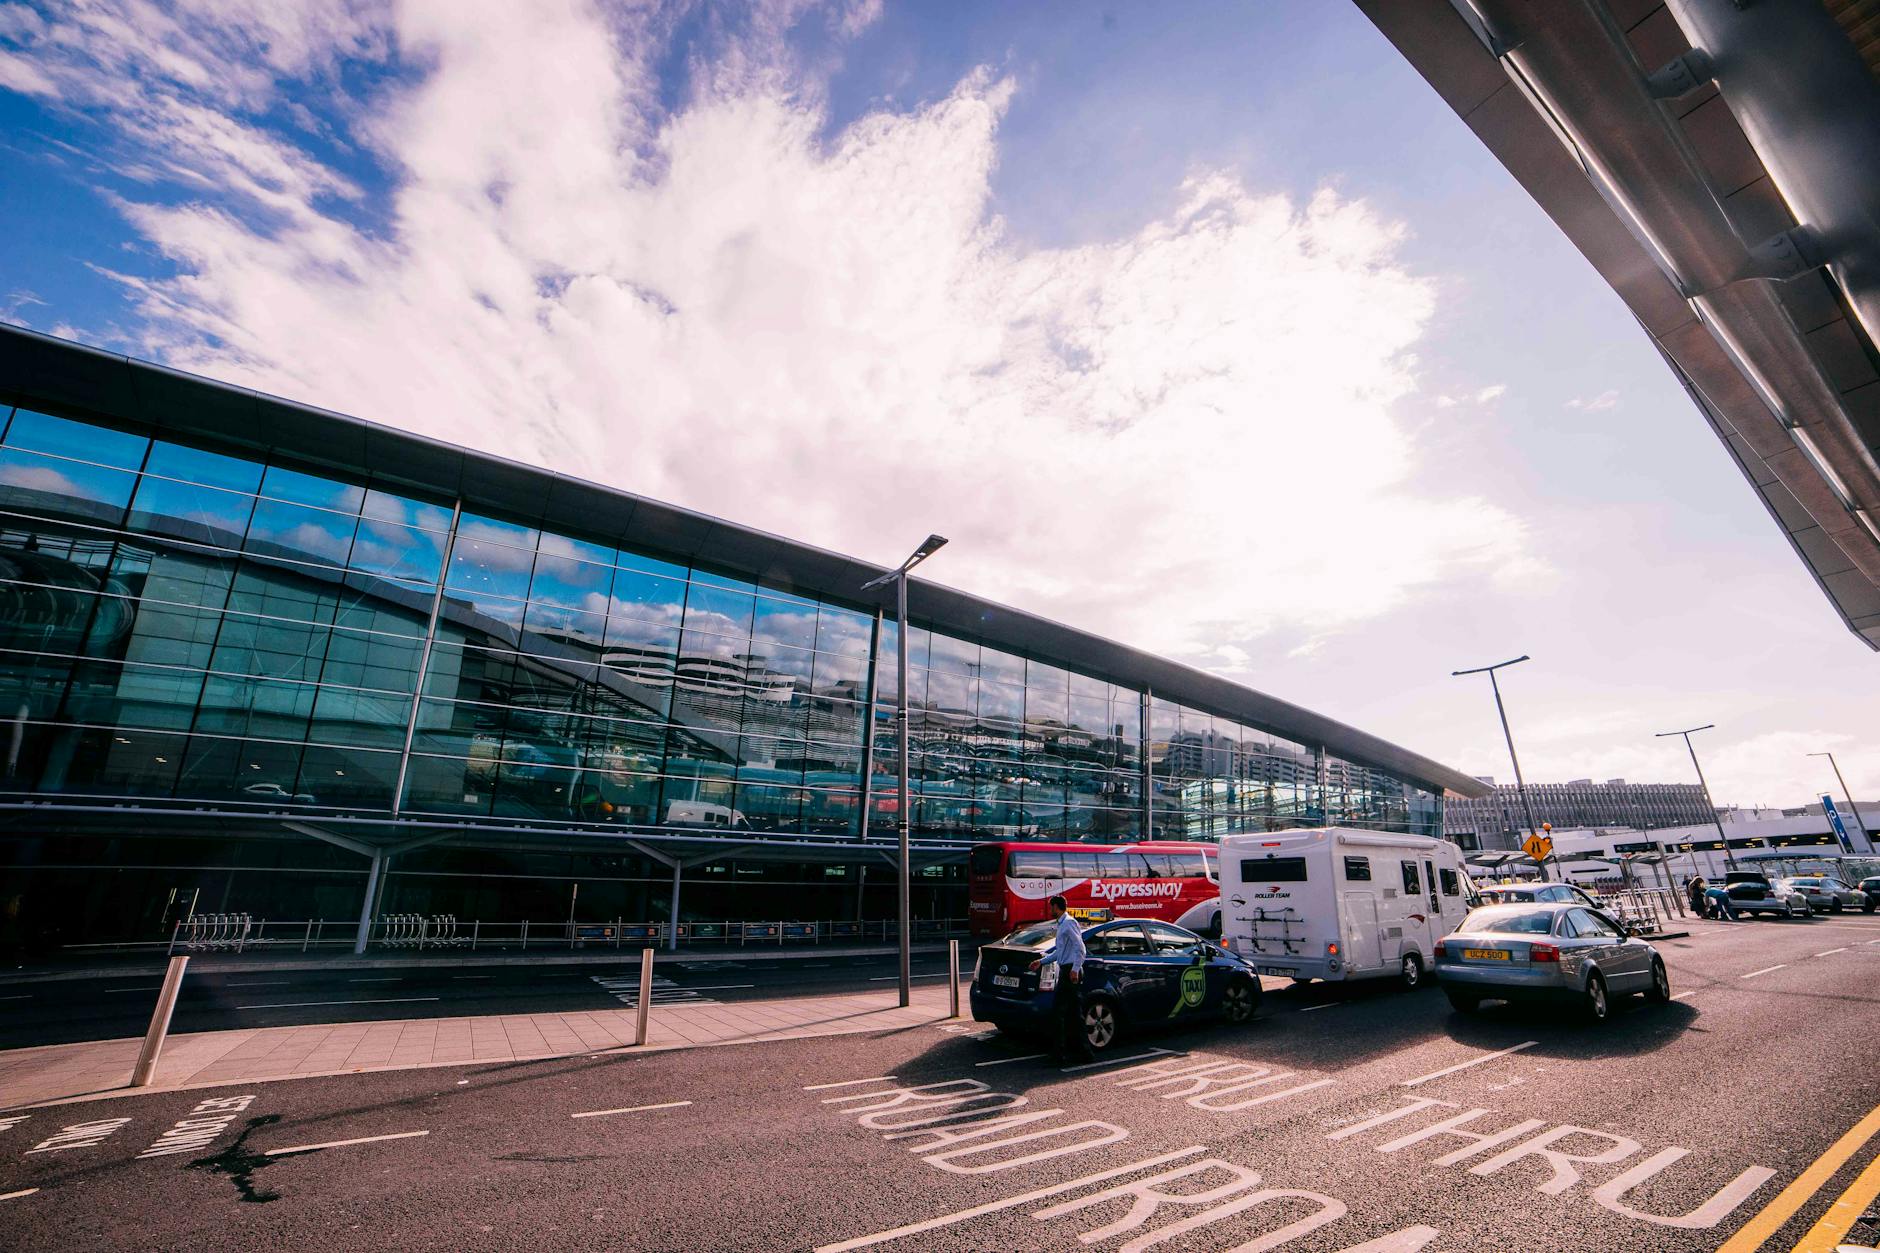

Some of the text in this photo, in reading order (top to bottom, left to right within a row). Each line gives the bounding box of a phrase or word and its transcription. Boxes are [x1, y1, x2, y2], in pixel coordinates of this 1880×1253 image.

[1091, 880, 1182, 902] Expressway
[1184, 979, 1204, 992] TAXI
[822, 1078, 1130, 1174] ROAD
[1325, 1095, 1777, 1229] THRU
